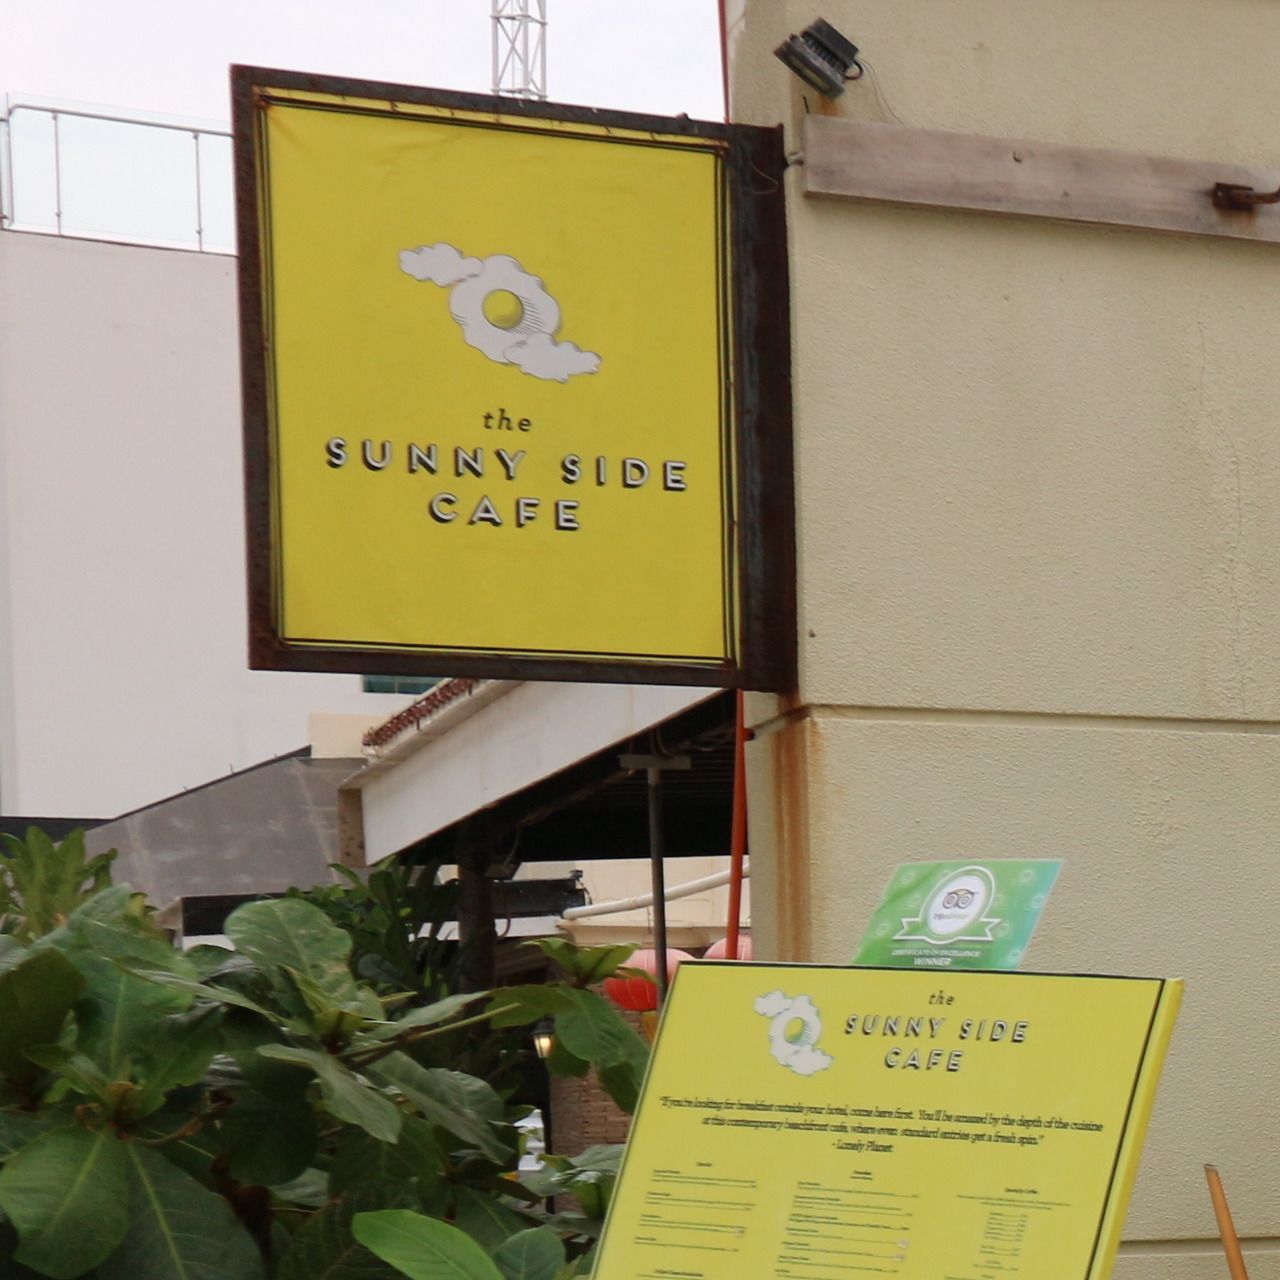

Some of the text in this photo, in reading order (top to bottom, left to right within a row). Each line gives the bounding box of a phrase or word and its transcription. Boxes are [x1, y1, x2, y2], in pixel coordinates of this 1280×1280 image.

[482, 408, 532, 433] the
[325, 437, 689, 492] SUNNY SIDE
[428, 492, 582, 531] CAFE
[913, 957, 952, 966] WINNER
[928, 990, 955, 1006] the
[843, 1013, 1030, 1044] SUNNY SIDE
[883, 1047, 964, 1073] CAFE
[692, 1097, 723, 1111] looking
[723, 1098, 736, 1110] for
[735, 1099, 774, 1112] breakfast
[774, 1102, 804, 1113] outside
[804, 1106, 825, 1116] your
[849, 1107, 873, 1117] come
[873, 1106, 894, 1118] here
[942, 1111, 952, 1122] be
[988, 1113, 1000, 1127] by
[1001, 1115, 1015, 1126] the
[1016, 1115, 1042, 1129] depth
[1043, 1116, 1055, 1128] of
[1055, 1117, 1069, 1129] the
[1069, 1119, 1104, 1132] cuisine
[710, 1115, 726, 1126] this
[726, 1118, 783, 1131] contemporary
[783, 1118, 829, 1131] beachfront
[850, 1122, 876, 1134] where
[876, 1126, 897, 1136] even
[900, 1126, 939, 1138] standard
[939, 1129, 970, 1140] entries
[969, 1132, 986, 1143] get
[992, 1131, 1016, 1143] fresh
[865, 1140, 893, 1153] Planet
